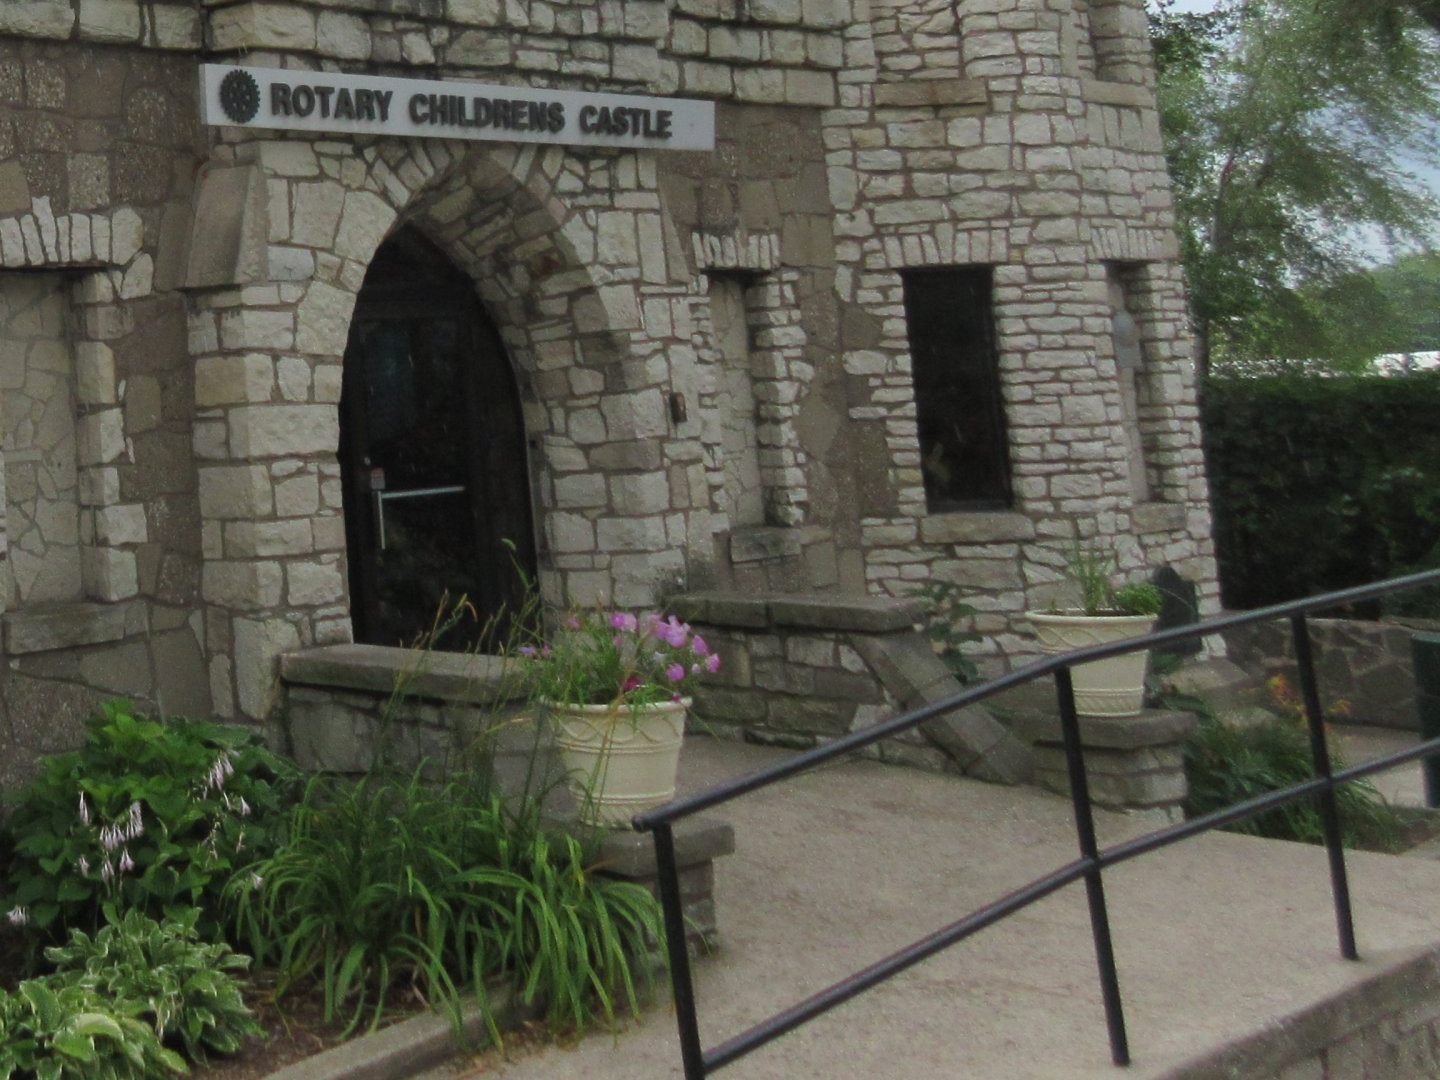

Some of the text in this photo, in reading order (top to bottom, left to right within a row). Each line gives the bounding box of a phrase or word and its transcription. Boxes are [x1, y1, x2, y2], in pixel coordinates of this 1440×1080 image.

[271, 83, 673, 139] ROTARY CHILDRENS CASTLE
